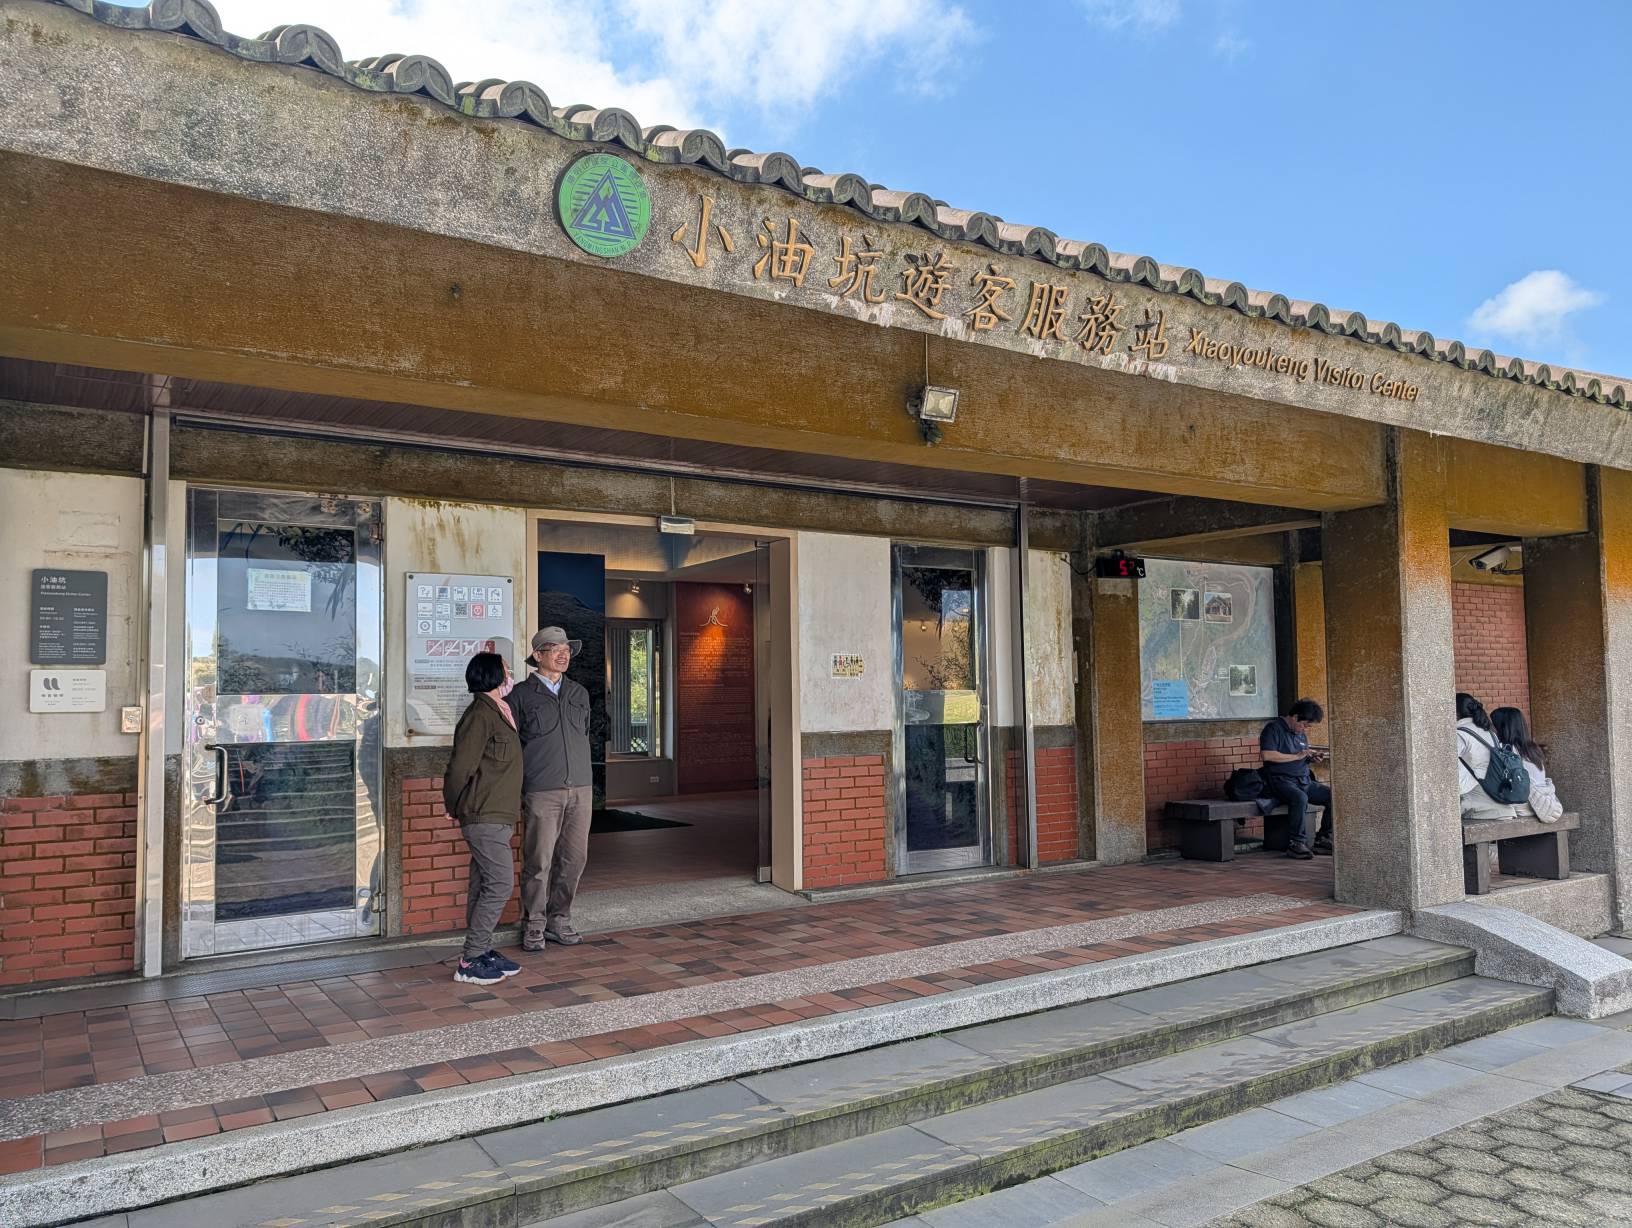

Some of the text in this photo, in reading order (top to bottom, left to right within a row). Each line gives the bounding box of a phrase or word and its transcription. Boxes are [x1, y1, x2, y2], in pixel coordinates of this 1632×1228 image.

[671, 194, 1169, 361] 小油坑遊客服務站
[1187, 327, 1422, 401] Xiaoyoukeng Visitor Center
